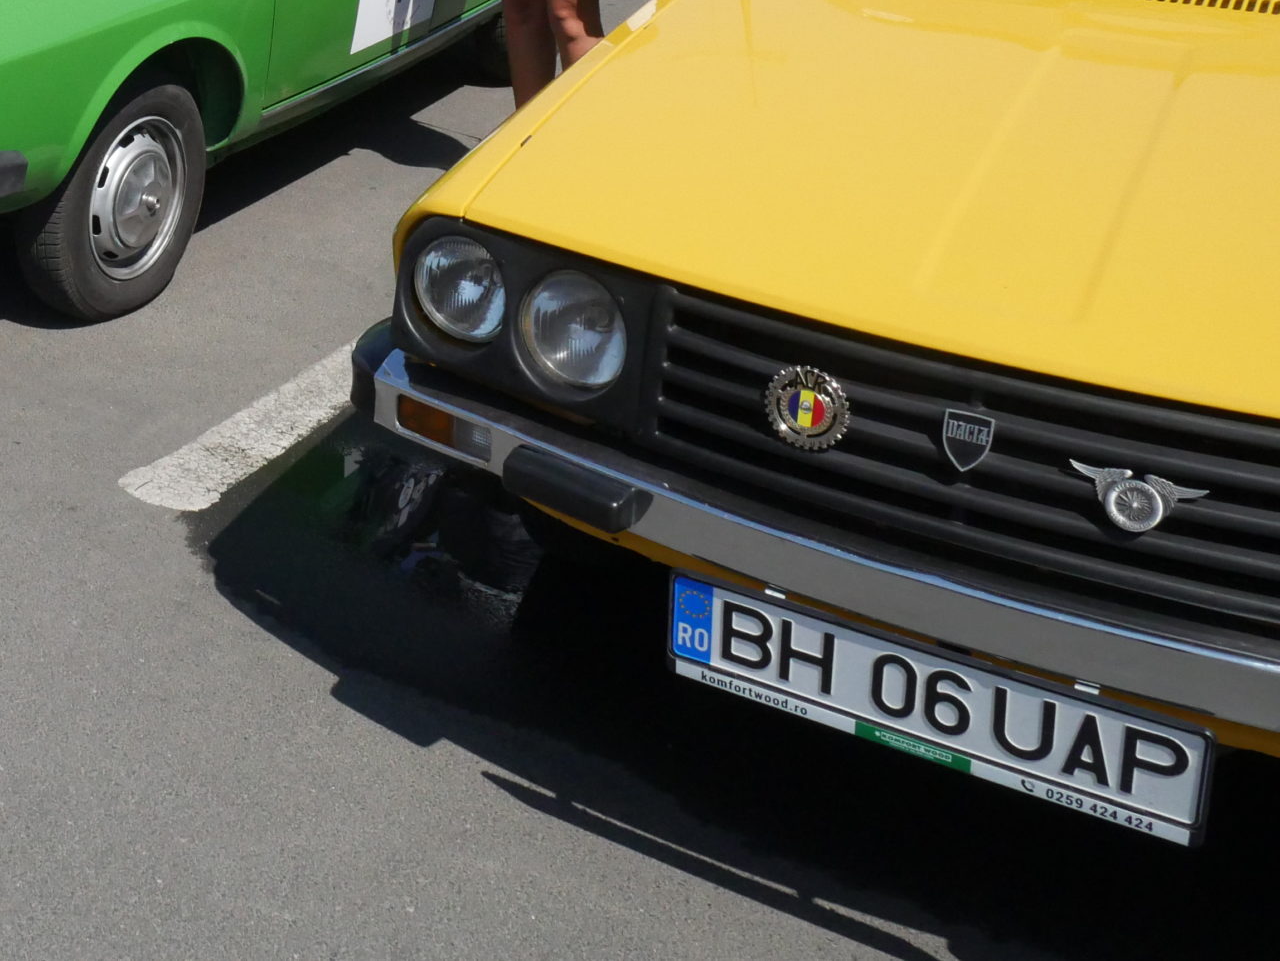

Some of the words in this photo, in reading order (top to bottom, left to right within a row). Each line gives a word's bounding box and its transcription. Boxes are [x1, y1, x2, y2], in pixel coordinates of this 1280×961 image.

[947, 419, 990, 445] DACIA
[677, 621, 709, 652] RO
[721, 600, 836, 696] BH
[701, 671, 808, 716] komfortwood.ro
[881, 733, 921, 751] KOMFORT
[923, 747, 951, 760] WOOD
[1046, 788, 1084, 809] 0259
[1090, 804, 1118, 821] 424
[1124, 816, 1153, 832] 424
